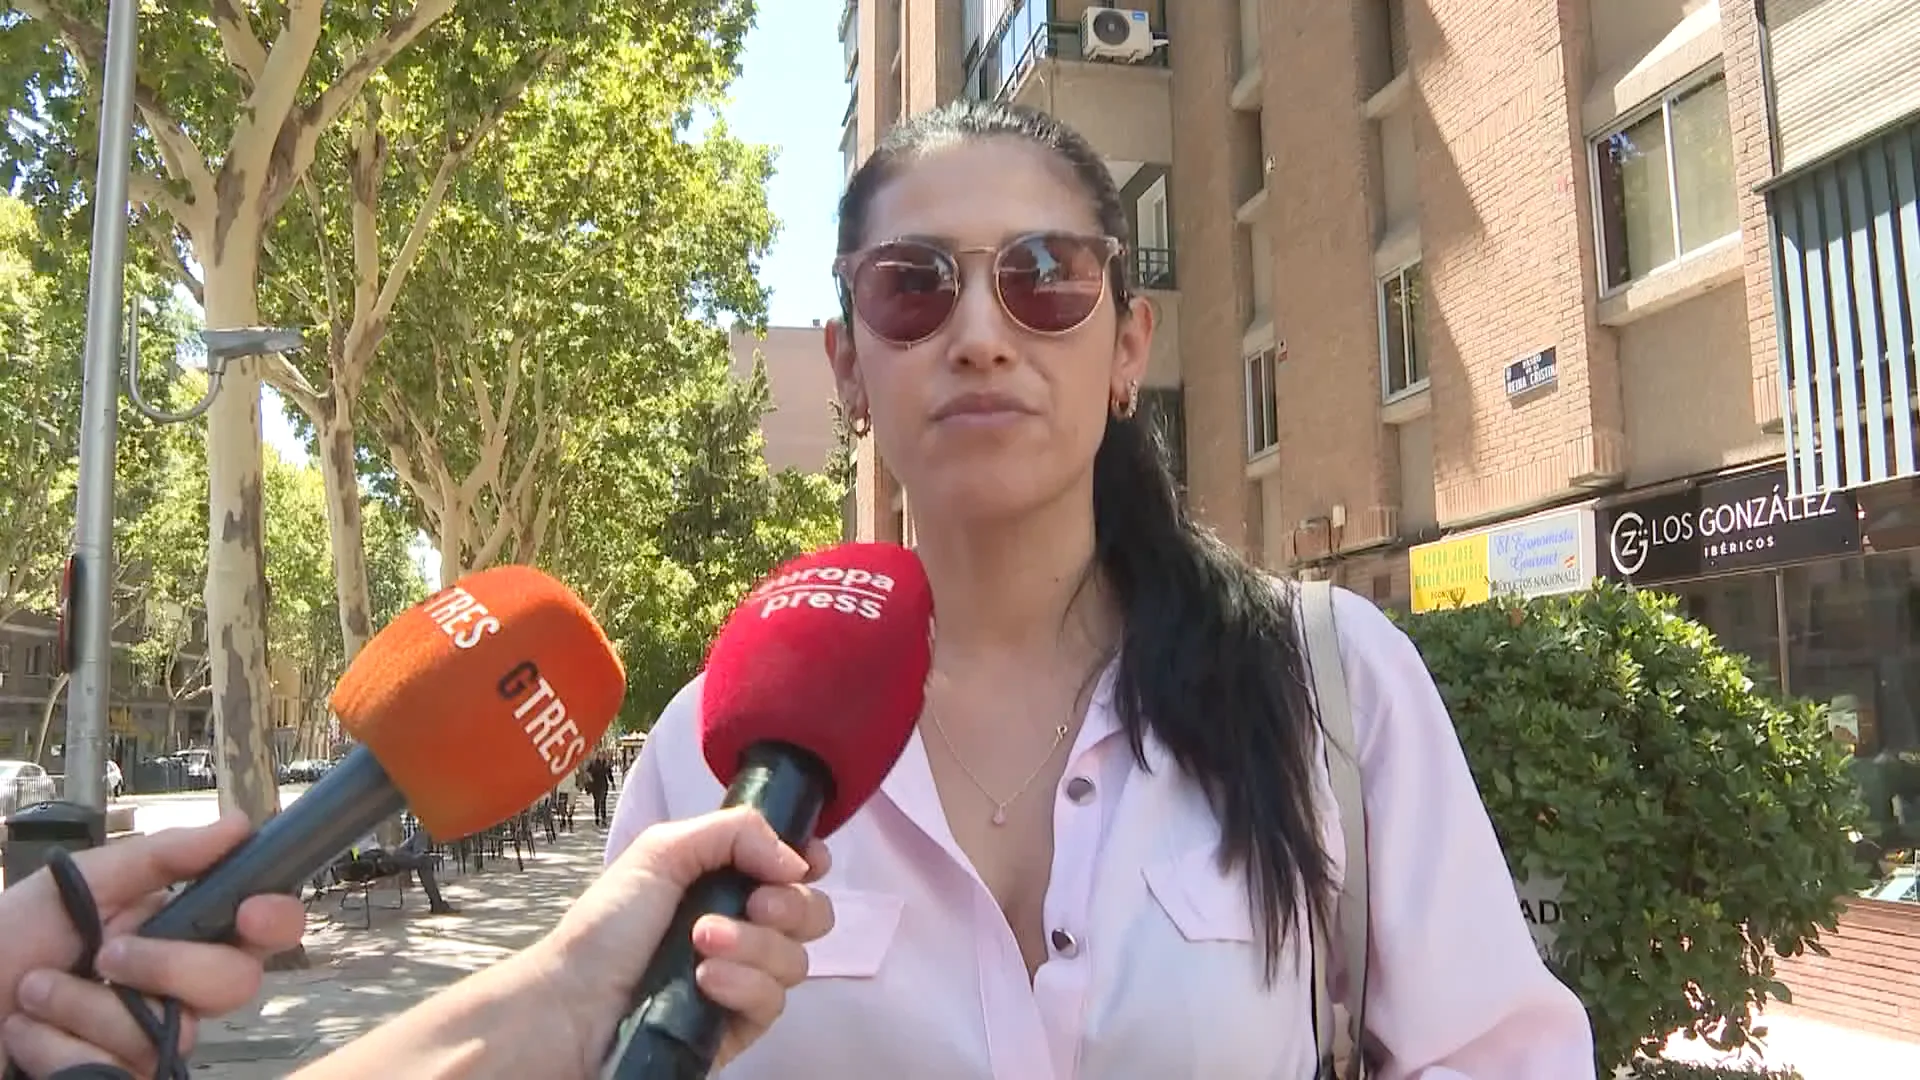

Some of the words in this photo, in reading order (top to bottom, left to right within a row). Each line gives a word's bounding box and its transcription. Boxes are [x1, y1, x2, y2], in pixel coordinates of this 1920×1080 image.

[1652, 512, 1693, 545] LOS
[1699, 484, 1836, 537] GONZÁLEZ
[1704, 535, 1775, 559] IBÉRICOS
[424, 585, 500, 649] TRES
[760, 591, 882, 619] press
[497, 661, 585, 775] GTRES
